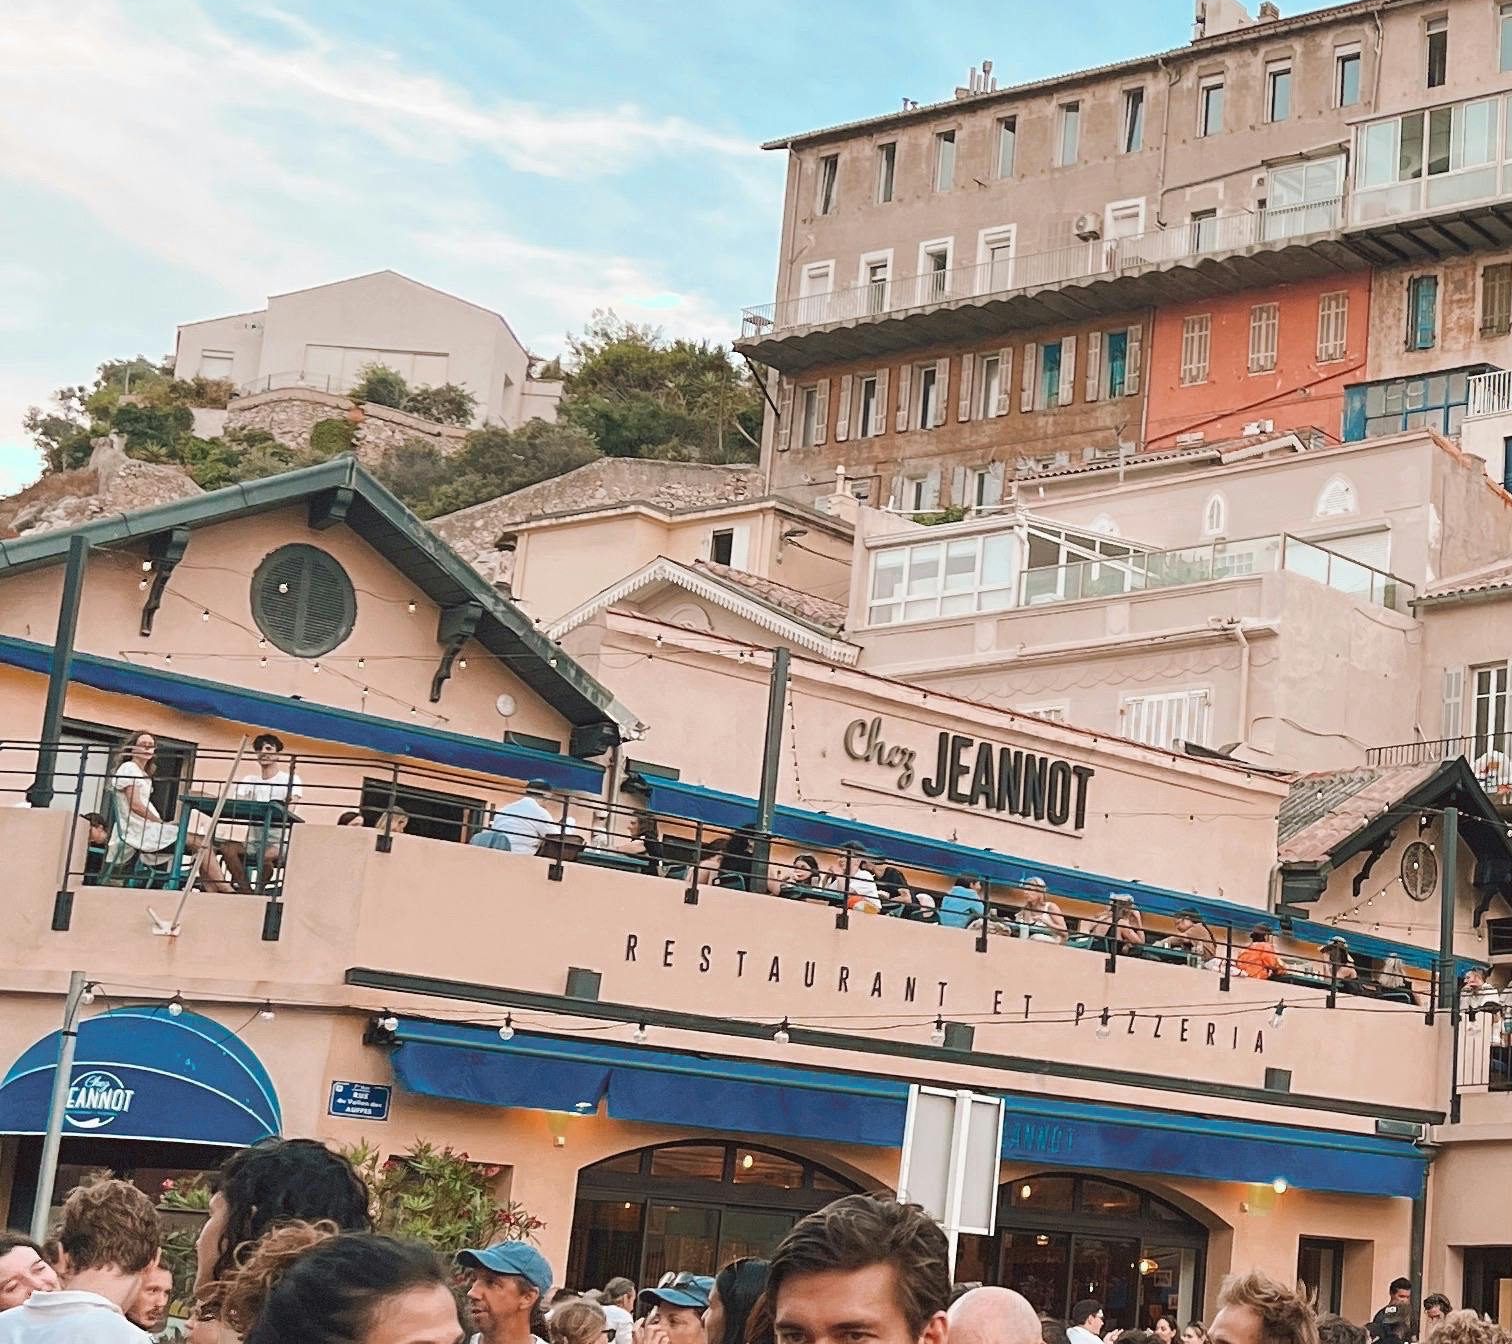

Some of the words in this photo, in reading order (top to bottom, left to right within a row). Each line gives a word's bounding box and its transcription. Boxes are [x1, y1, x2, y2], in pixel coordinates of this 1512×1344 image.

[844, 716, 917, 790] Chez
[922, 731, 1095, 830] JEANNOT
[625, 934, 947, 1006] RESTAURANT
[993, 990, 1032, 1019] ET
[1075, 1002, 1263, 1053] PZZERIA
[66, 1087, 135, 1112] EANNOT
